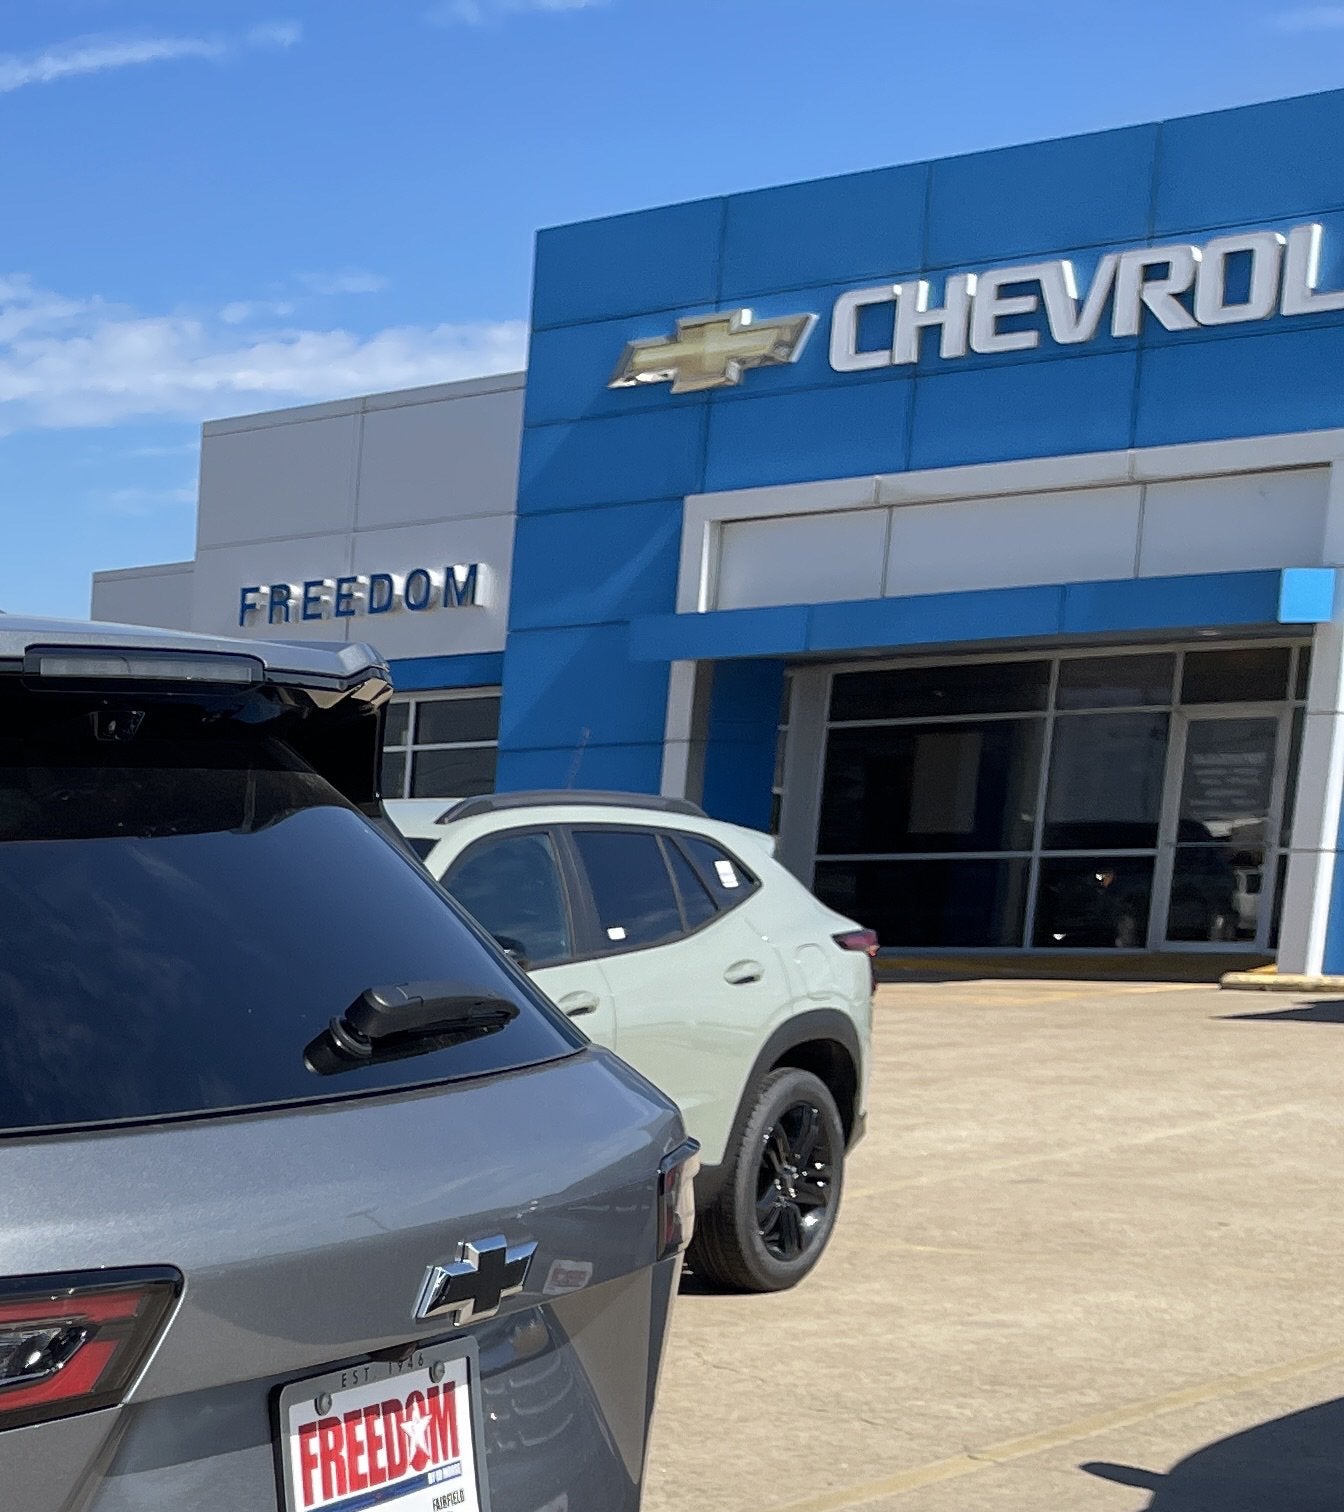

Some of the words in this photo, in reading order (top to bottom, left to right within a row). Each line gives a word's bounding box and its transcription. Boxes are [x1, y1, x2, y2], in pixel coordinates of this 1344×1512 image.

[239, 563, 480, 627] FREEDOM
[298, 1381, 460, 1507] FREEDOM
[432, 1488, 465, 1512] FAIRFIELD
